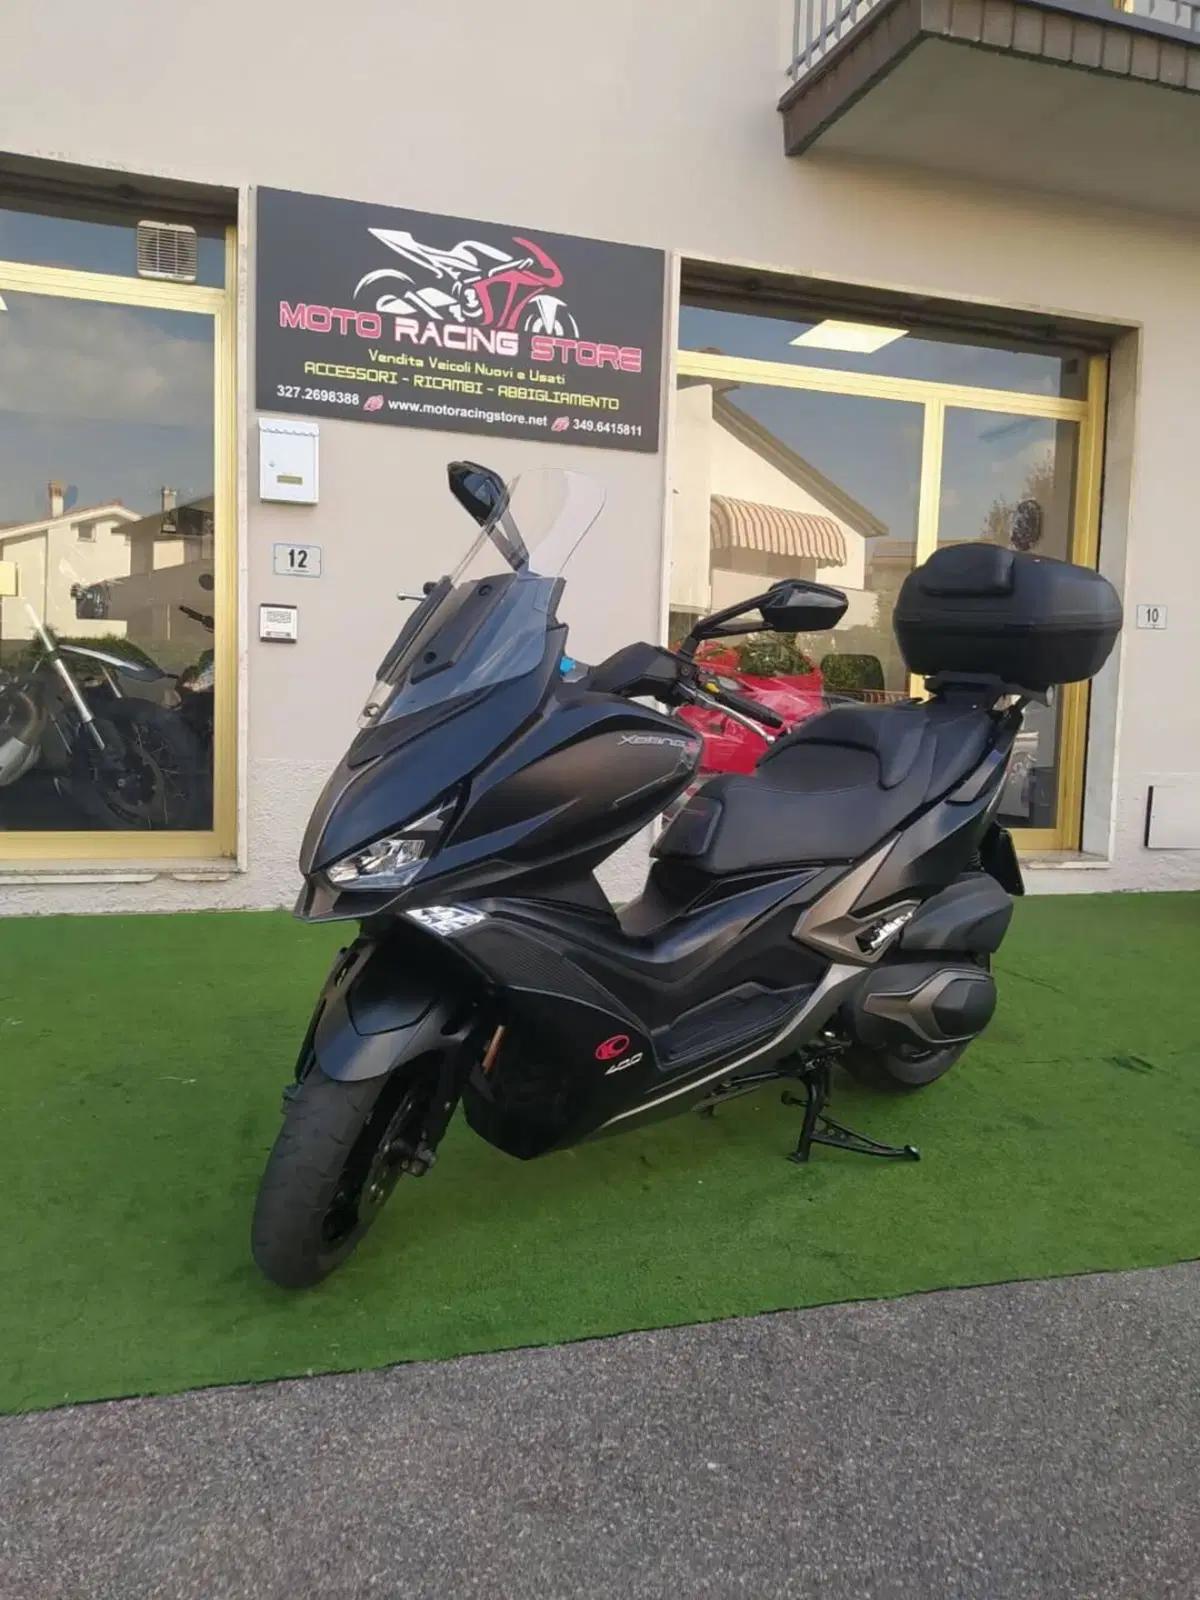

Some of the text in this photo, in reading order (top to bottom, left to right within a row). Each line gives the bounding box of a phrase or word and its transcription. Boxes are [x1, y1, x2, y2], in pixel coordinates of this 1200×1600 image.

[279, 301, 643, 373] MOTO RACING STORE
[368, 349, 566, 385] Vendita Veicoli Nuovi e Usati
[304, 361, 398, 385] ACCESSORI
[413, 374, 483, 395] RICAMBI
[498, 384, 619, 411] ABBIGLIAMENTO
[276, 385, 642, 437] 327.2698388 www.motoracingstore.net 349.6415811
[288, 549, 308, 568] 12
[1147, 607, 1159, 623] 10
[604, 1052, 643, 1075] 400
